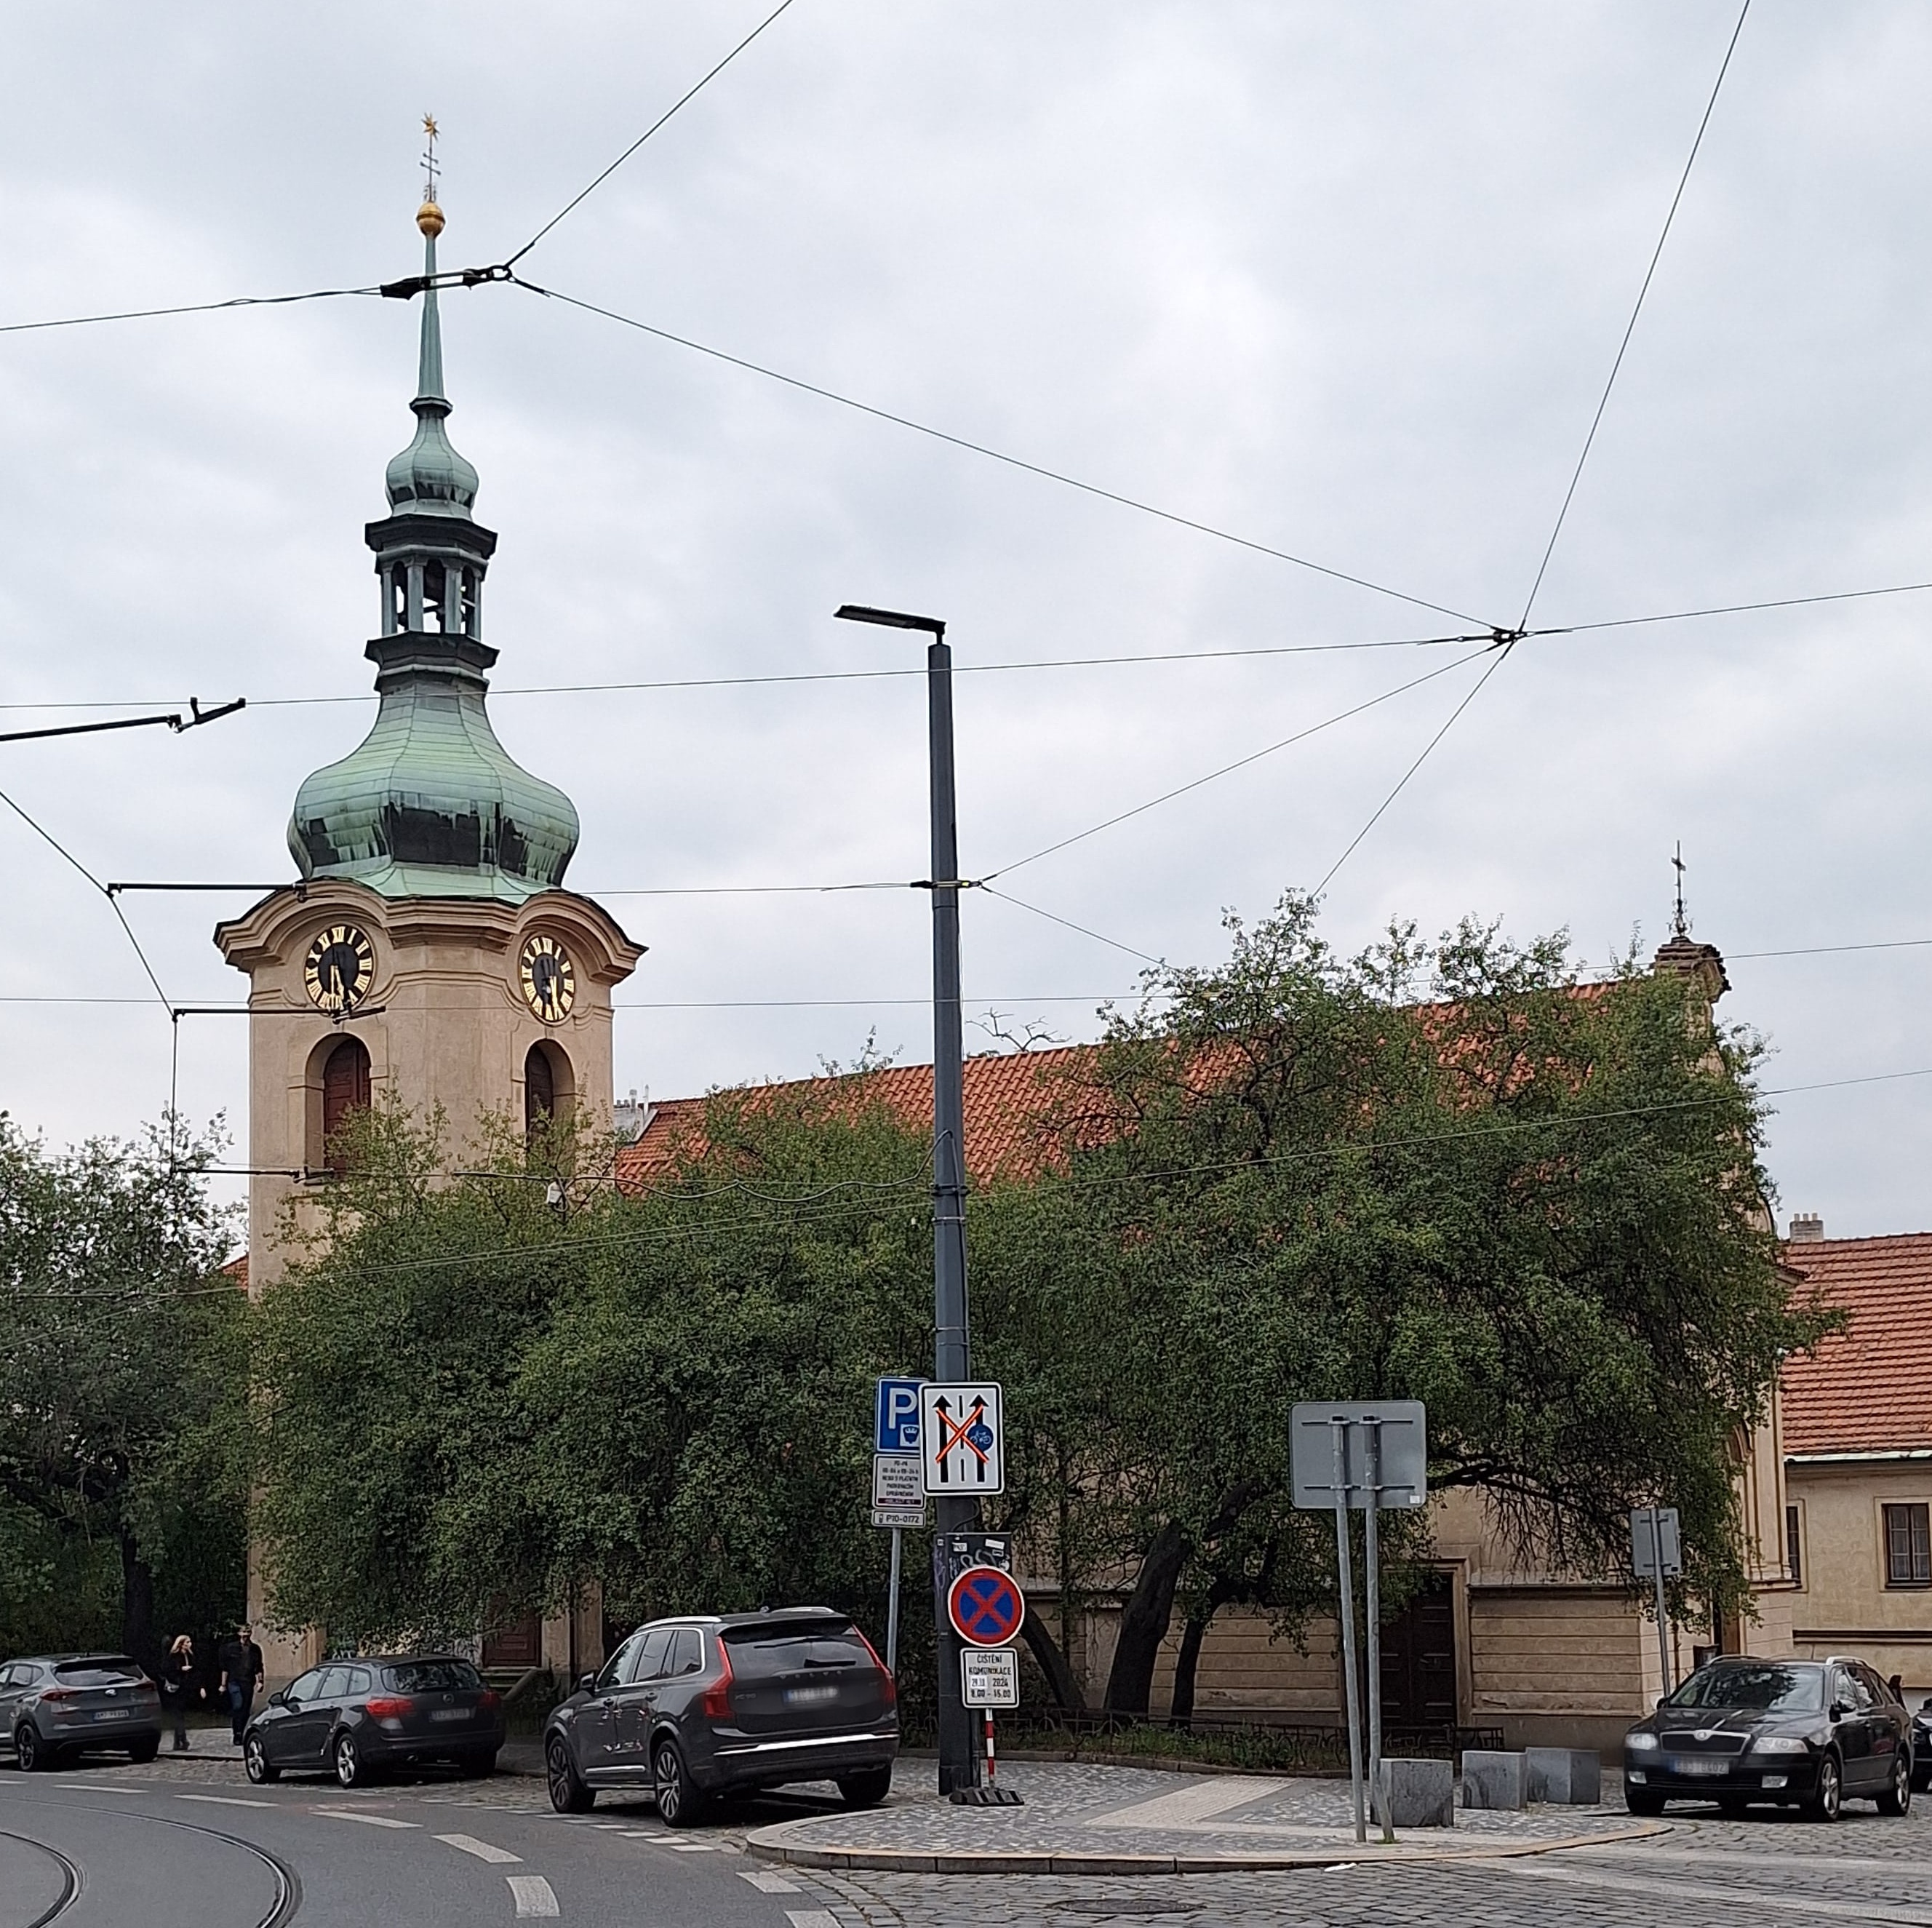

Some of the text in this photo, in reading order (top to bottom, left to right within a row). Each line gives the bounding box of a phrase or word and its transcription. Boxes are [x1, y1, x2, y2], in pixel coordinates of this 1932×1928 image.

[888, 1387, 917, 1430] P
[886, 1514, 919, 1523] P10-0172
[977, 1654, 1002, 1664] ČIŠTĚNÍ
